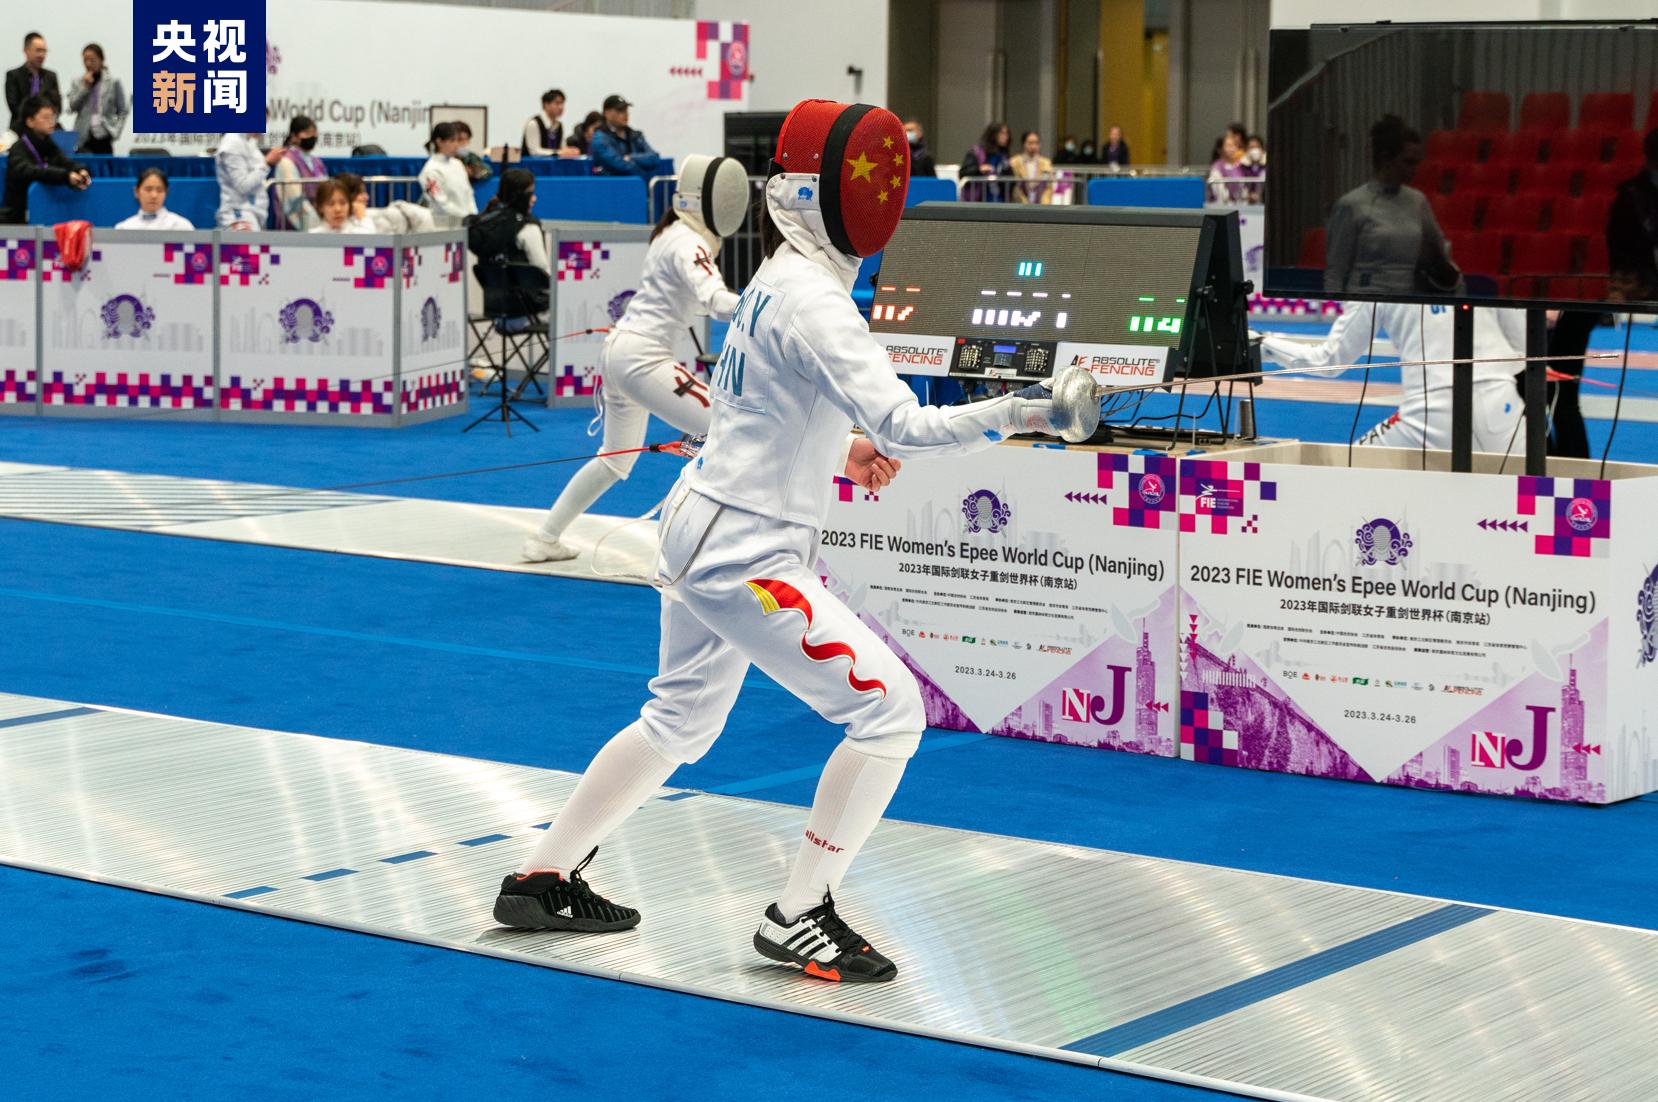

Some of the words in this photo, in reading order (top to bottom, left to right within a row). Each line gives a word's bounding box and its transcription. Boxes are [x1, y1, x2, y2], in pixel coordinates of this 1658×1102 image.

[271, 100, 324, 121] World
[328, 101, 365, 127] Cup
[1090, 365, 1155, 376] FENCING
[1200, 496, 1217, 509] FIE
[821, 529, 856, 548] 2023
[860, 532, 884, 550] FIE
[887, 535, 956, 558] Women's
[960, 542, 998, 564] Epee
[1001, 545, 1048, 566] World
[1052, 550, 1085, 573] Cup
[1088, 553, 1165, 582] (Nanjing)
[1190, 564, 1231, 584] 2023
[1235, 567, 1263, 586] FIE
[1267, 569, 1346, 593] Women's
[1351, 575, 1397, 598] Epee
[1400, 578, 1456, 601] World
[1461, 583, 1500, 608] Cup
[1504, 585, 1597, 615] (Nanjing)
[954, 665, 1018, 680] 2023.3.24-3.26
[1343, 709, 1417, 724] 2023.3.24-3.26
[805, 829, 845, 853] allstar
